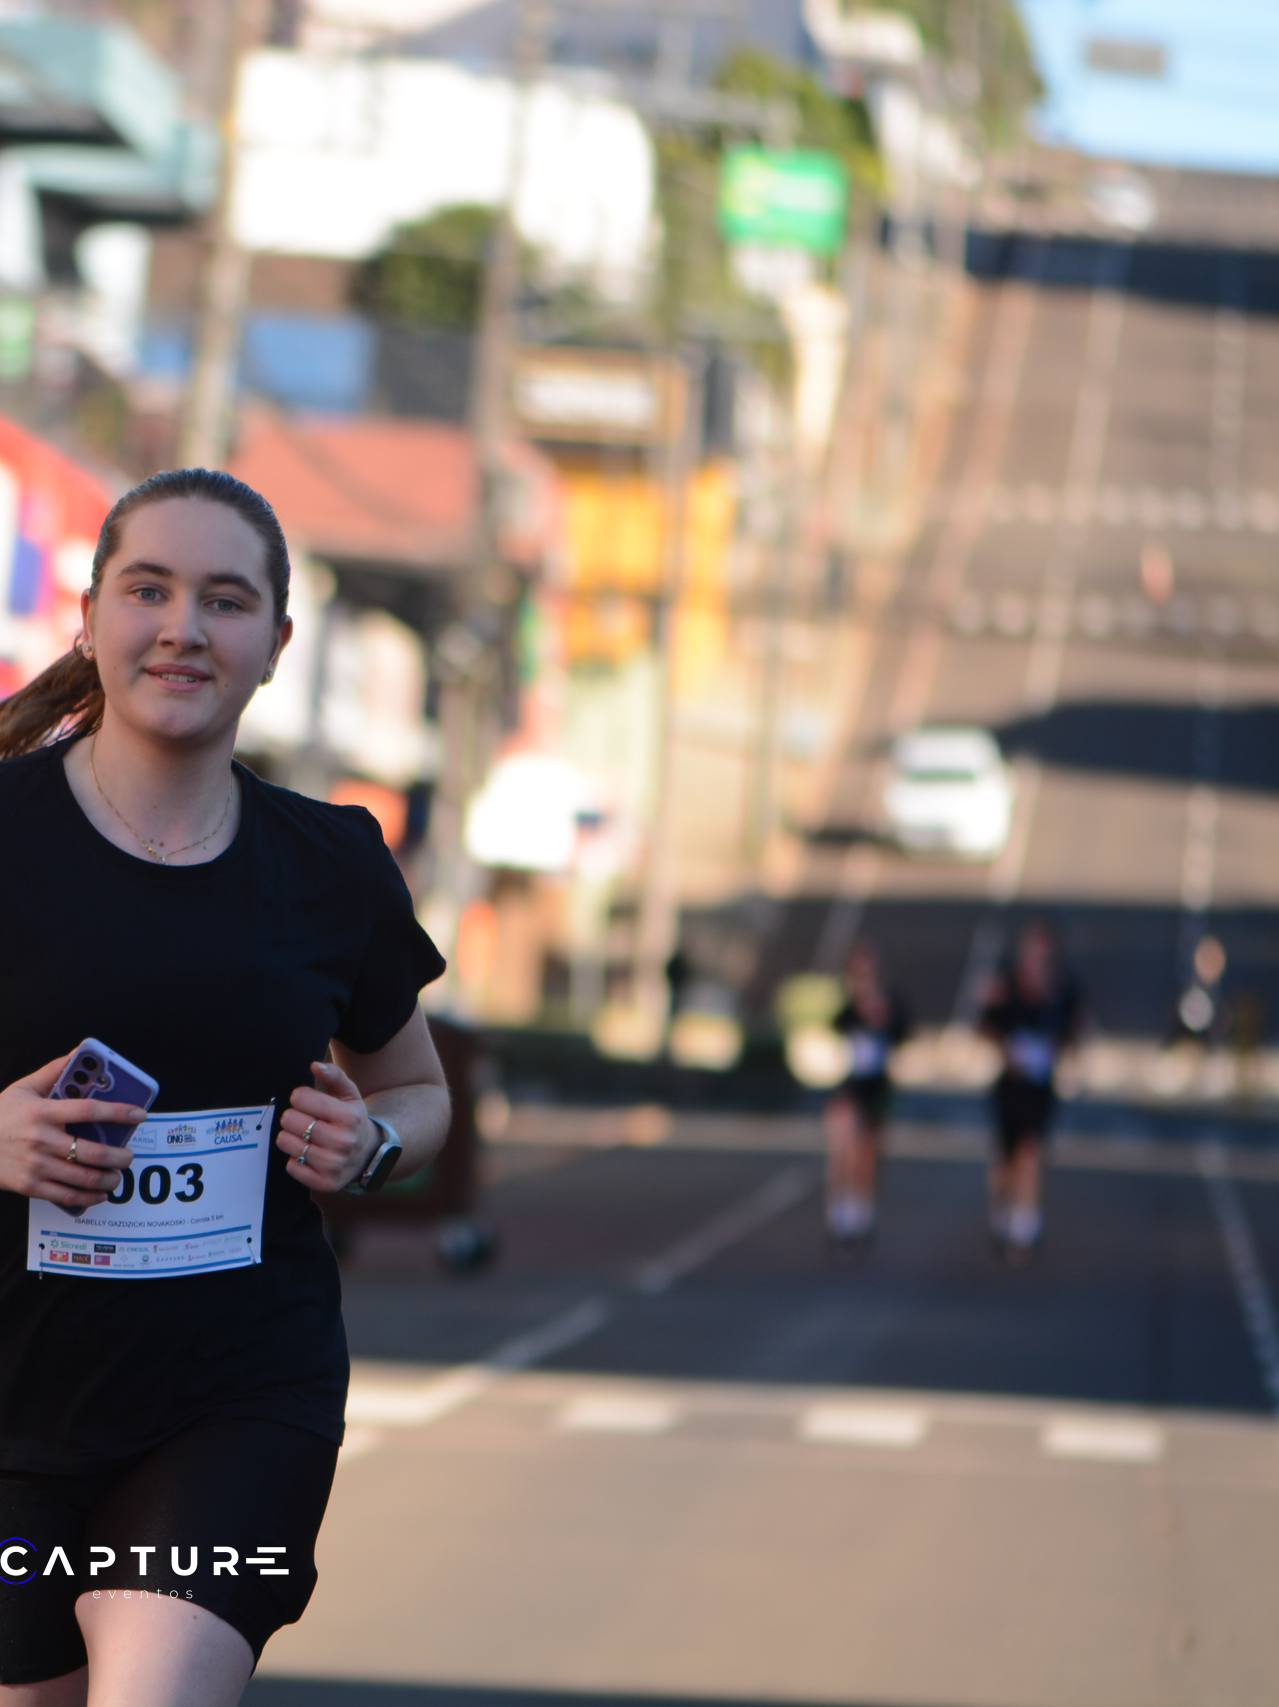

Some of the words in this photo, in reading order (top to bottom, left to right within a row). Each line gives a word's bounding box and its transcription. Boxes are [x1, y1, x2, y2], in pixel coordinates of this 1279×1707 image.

[167, 1134, 183, 1144] ONG
[214, 1134, 242, 1145] CAUSA
[74, 1217, 107, 1227] ISABELLY
[147, 1219, 186, 1227] NOVAKOSKI
[190, 1216, 210, 1225] Corrida
[61, 1241, 87, 1250] Sicredi
